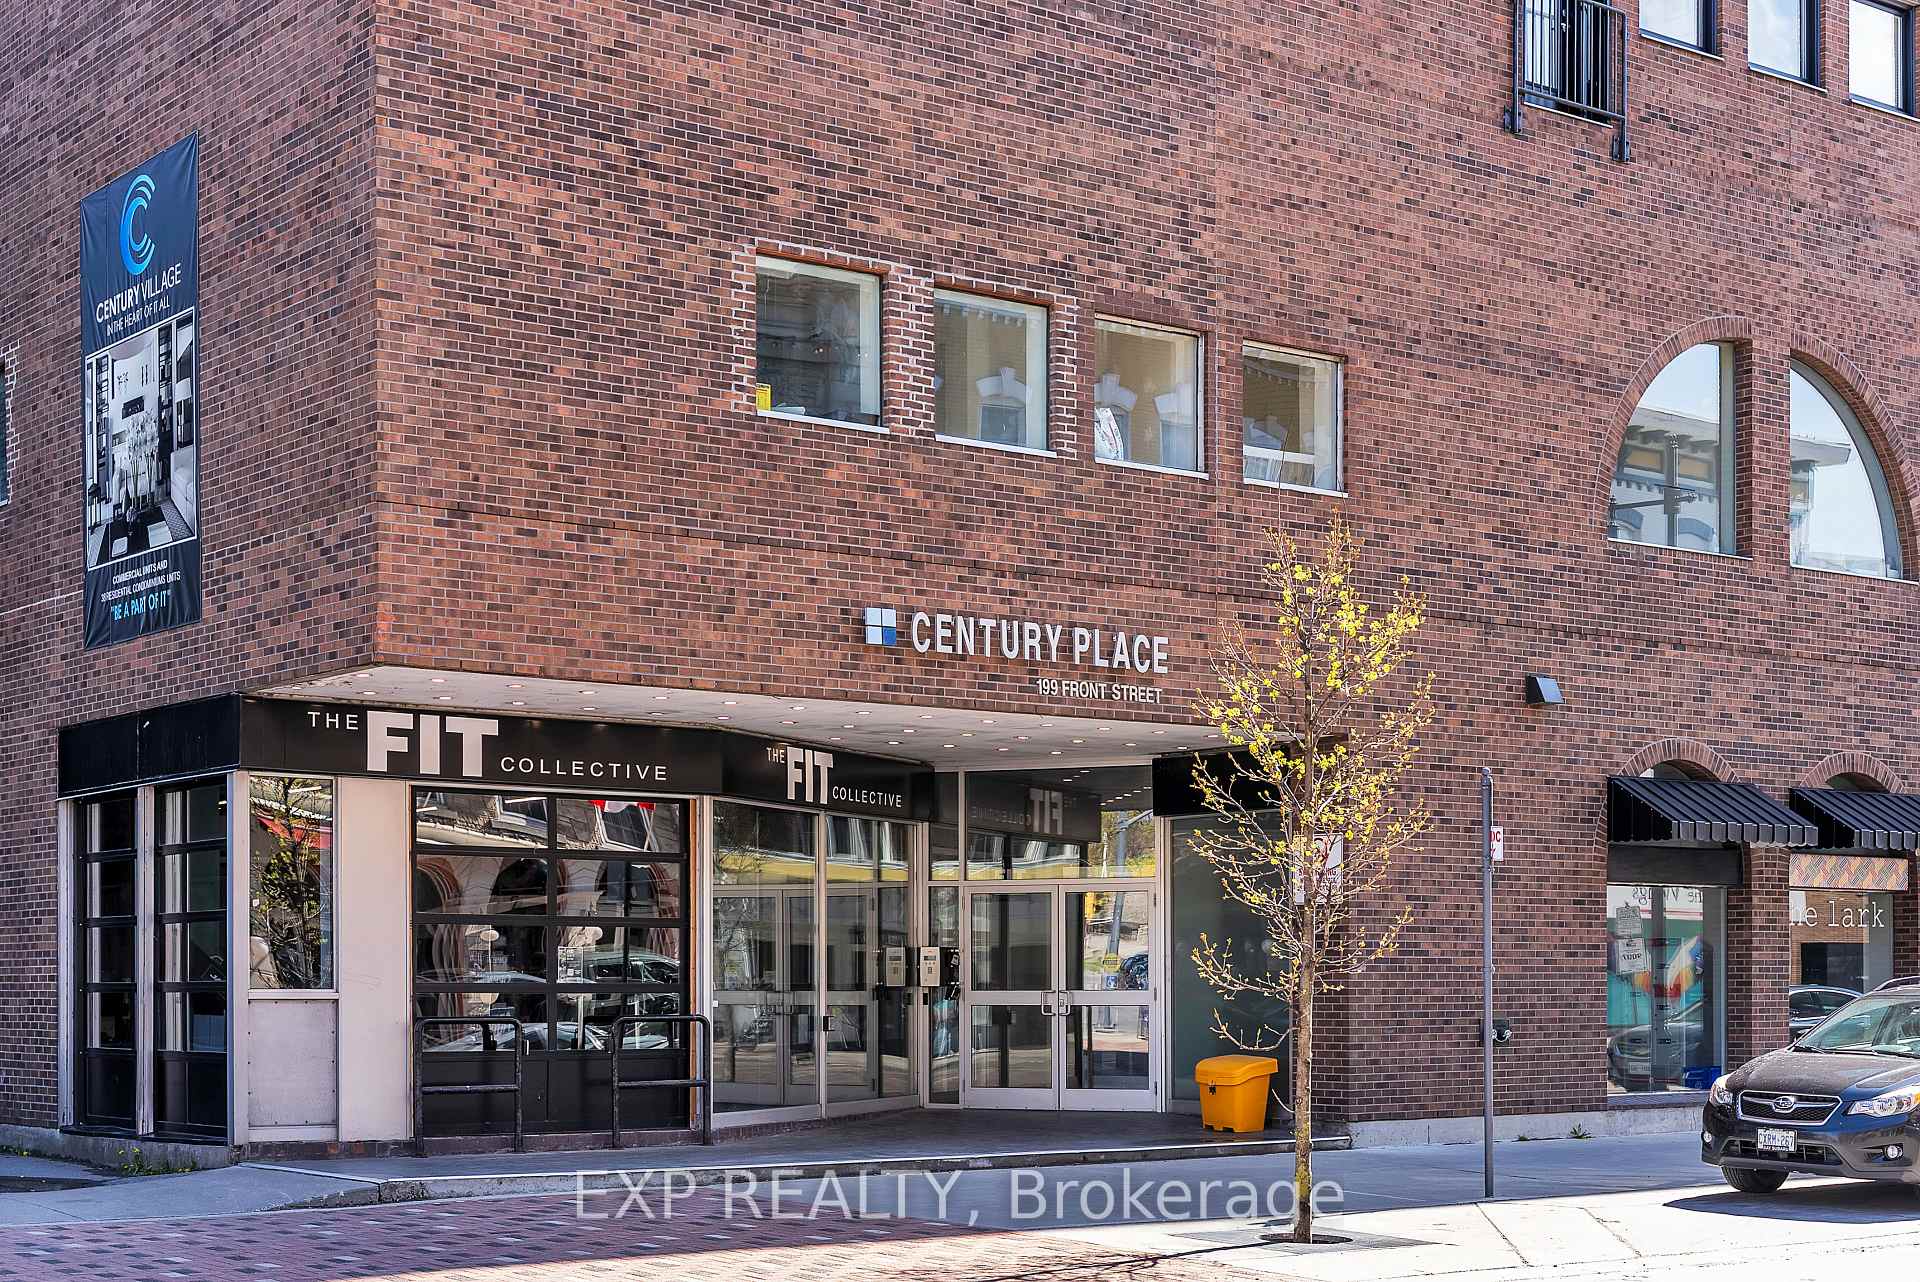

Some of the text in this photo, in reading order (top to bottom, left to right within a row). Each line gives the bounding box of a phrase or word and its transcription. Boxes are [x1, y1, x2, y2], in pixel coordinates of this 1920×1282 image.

[96, 262, 181, 323] CENTURY VILLAGE
[107, 295, 170, 336] IN THE HEART OF IT ALL
[106, 586, 132, 601] RESIDENTIAL
[166, 571, 181, 584] UNITS
[112, 560, 168, 585] COMMERCIAL UNITS AND
[123, 601, 130, 618] A
[131, 596, 146, 616] PART
[148, 592, 159, 610] OF
[912, 611, 1169, 674] CENTURY PLACE
[1036, 678, 1163, 704] 199 FRONT STREET
[307, 710, 668, 781] THE FIT COLLECTIVE
[766, 745, 902, 808] THE FIT COLLECTIVE
[1790, 900, 1885, 928] he lark
